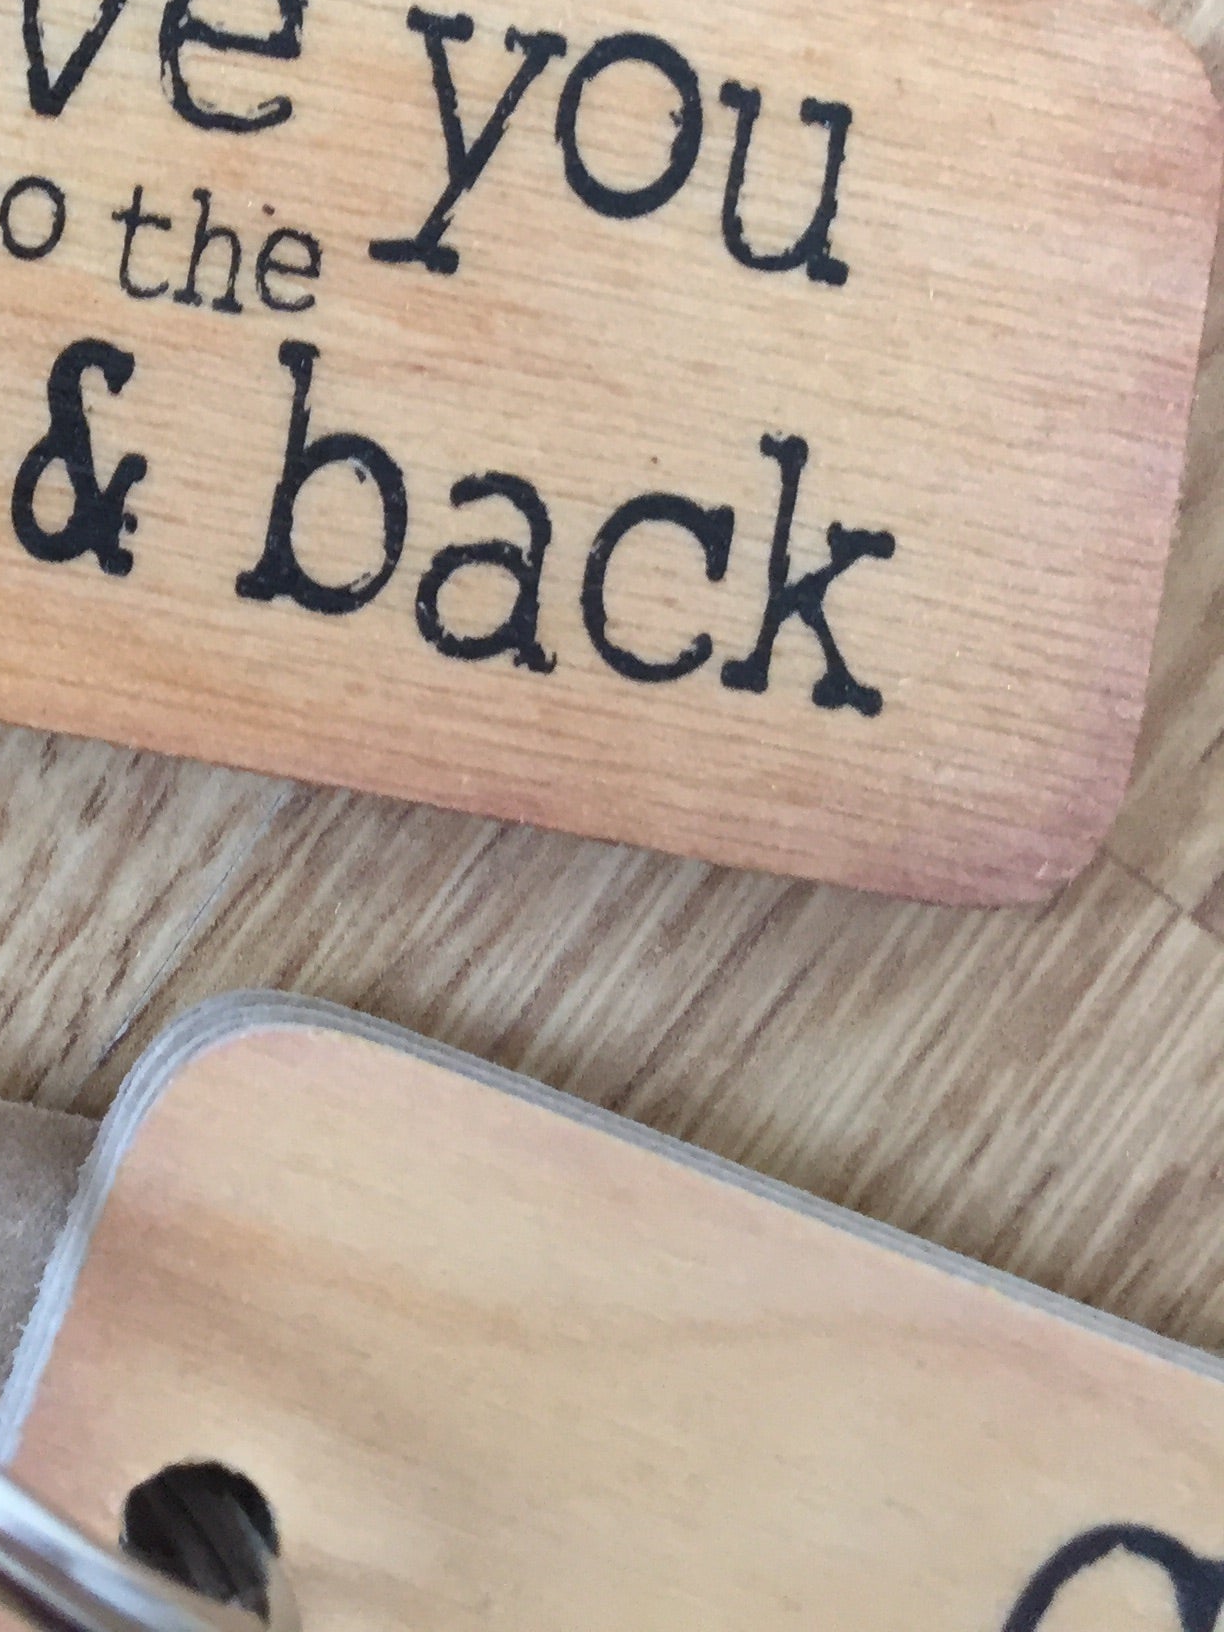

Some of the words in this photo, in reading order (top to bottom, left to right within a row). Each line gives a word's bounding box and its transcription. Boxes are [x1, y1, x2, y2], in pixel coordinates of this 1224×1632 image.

[110, 183, 324, 316] the
[367, 4, 854, 288] you
[9, 336, 149, 578] &
[233, 338, 897, 720] back
